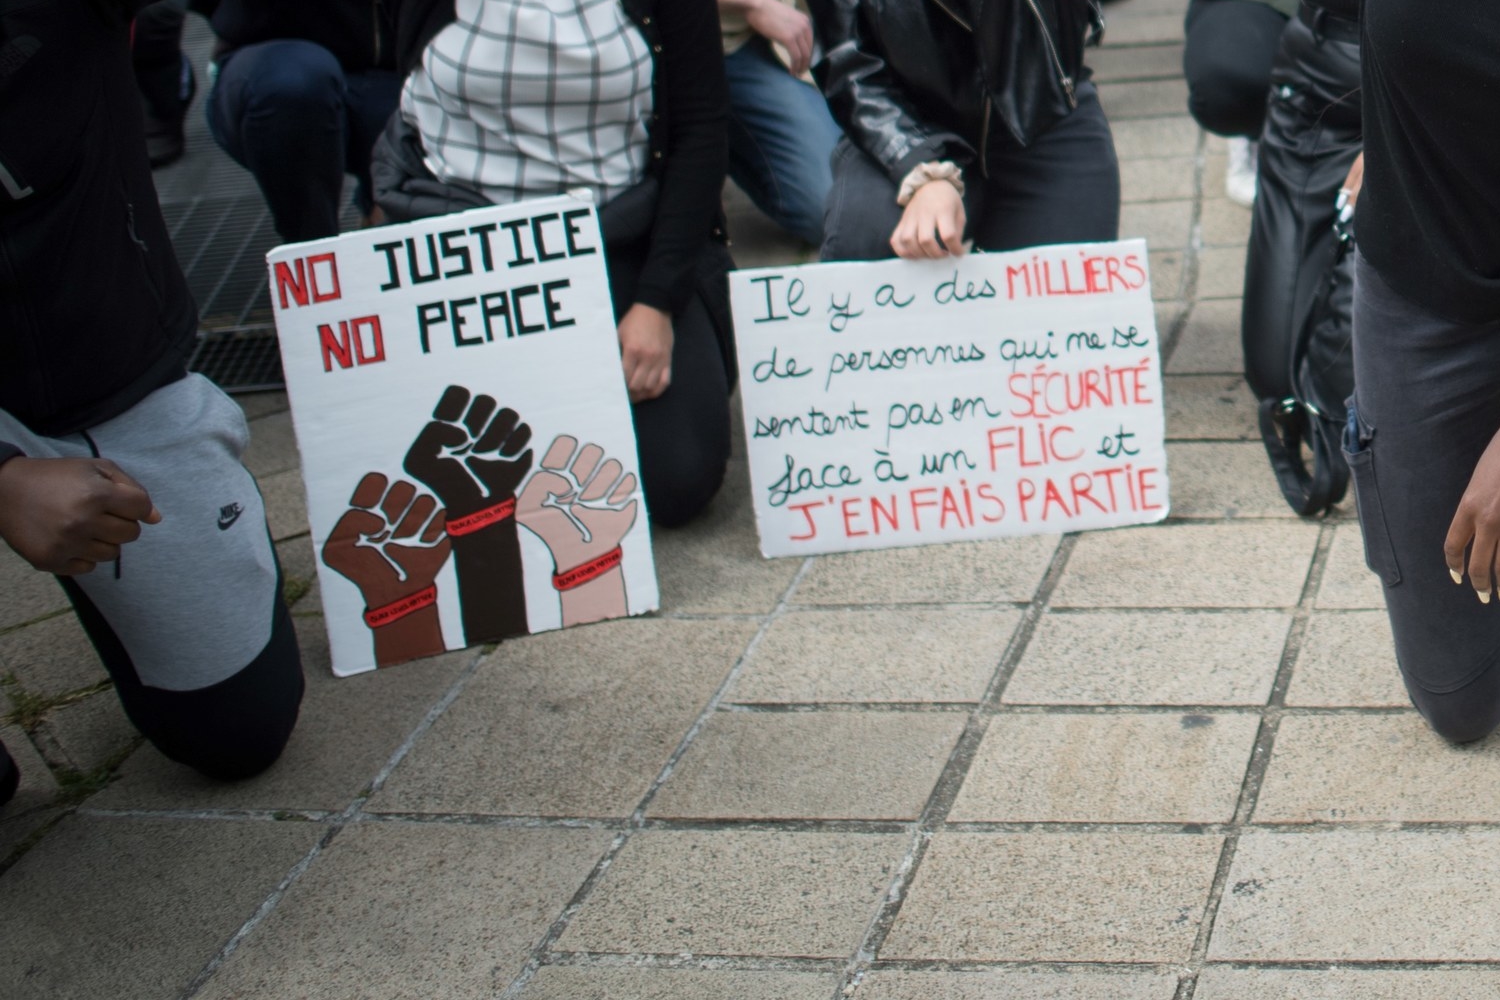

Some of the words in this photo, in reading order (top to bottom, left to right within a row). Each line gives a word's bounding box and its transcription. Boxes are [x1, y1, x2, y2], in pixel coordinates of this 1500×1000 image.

[273, 252, 341, 310] NO
[373, 207, 596, 292] JUSTICE
[317, 314, 386, 373] NO
[416, 278, 576, 354] PEACE
[750, 275, 811, 323] Il
[827, 291, 864, 333] y
[874, 283, 916, 308] a
[934, 268, 997, 304] des
[753, 346, 814, 383] de
[825, 342, 986, 392] personnes
[1000, 331, 1059, 374] qui
[753, 400, 870, 438] sentent
[768, 453, 862, 508] face
[874, 448, 909, 482] à
[920, 449, 976, 476] un
[1096, 424, 1140, 458] et
[219, 502, 240, 521] NIKE
[788, 495, 899, 541] J'EN
